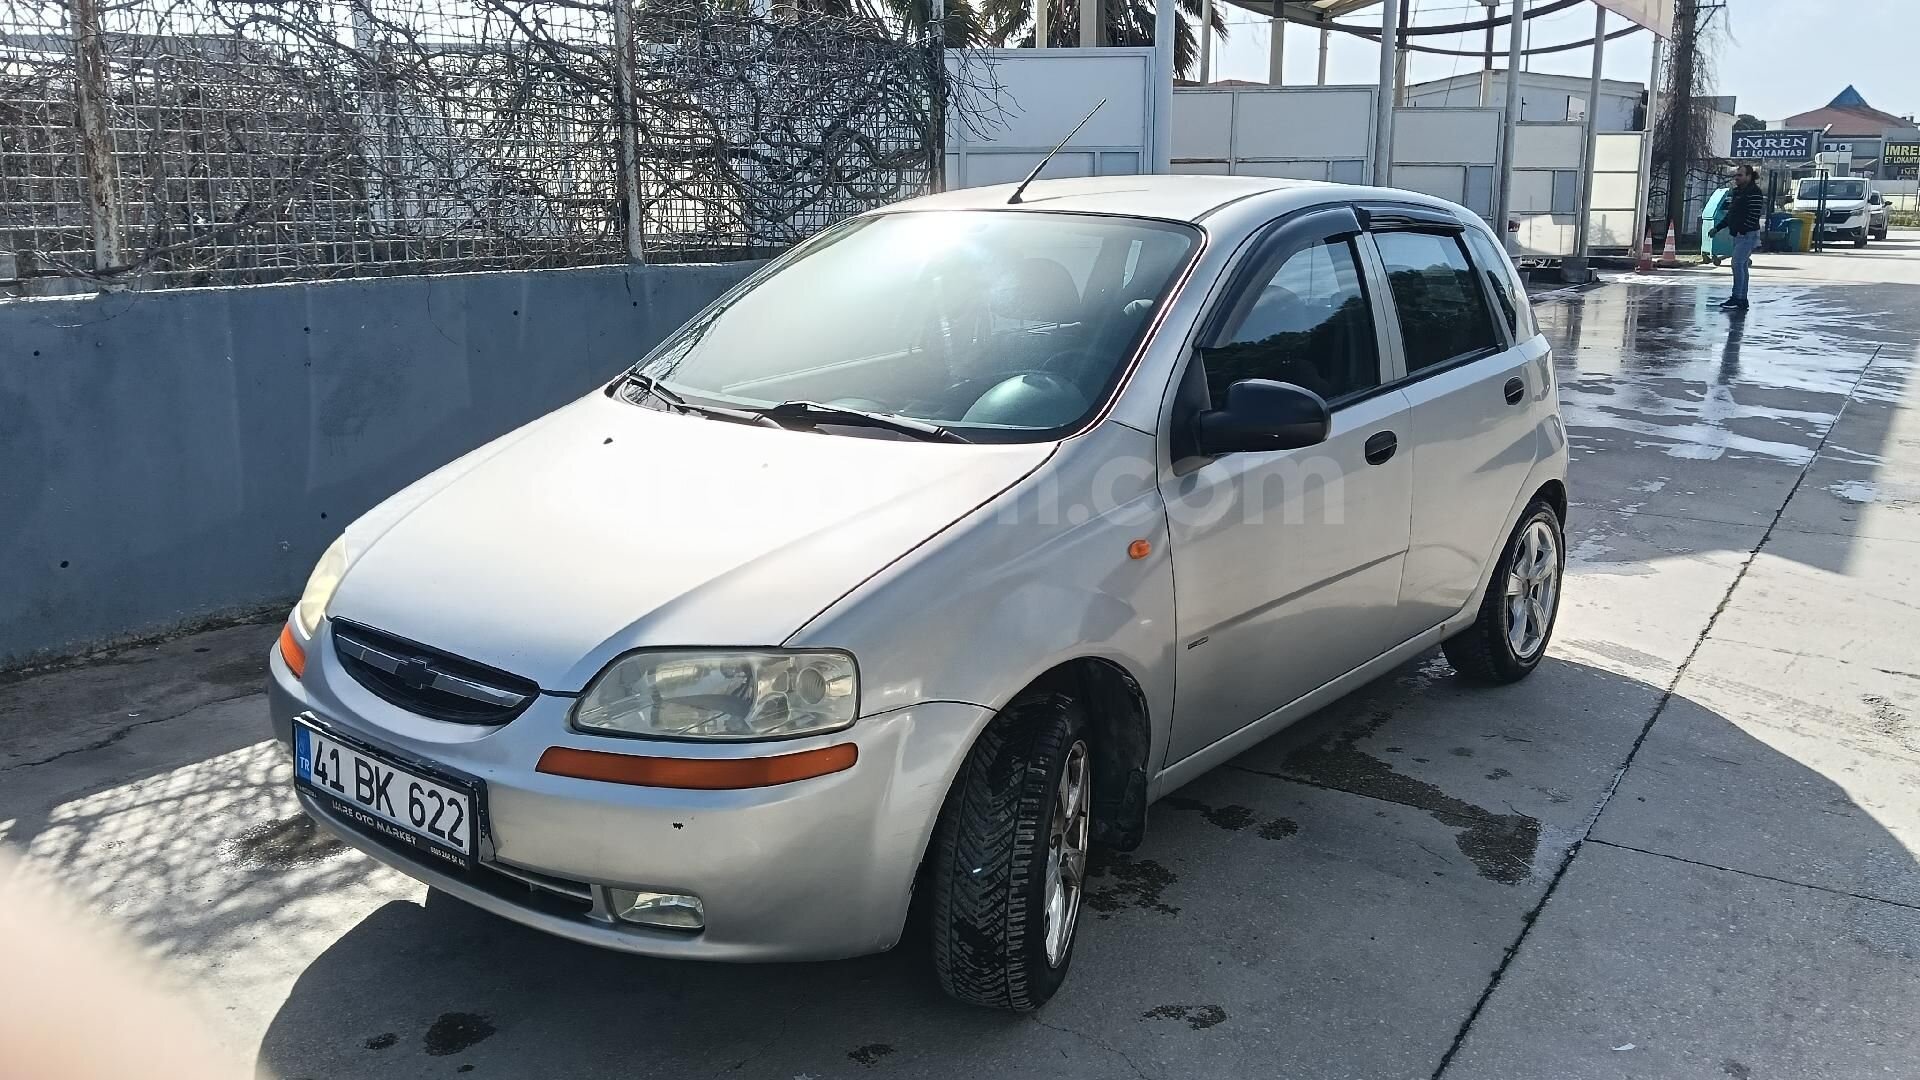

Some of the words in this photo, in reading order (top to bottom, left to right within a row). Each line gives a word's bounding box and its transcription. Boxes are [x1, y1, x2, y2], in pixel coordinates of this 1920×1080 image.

[1752, 149, 1806, 157] LOKANTASI
[1885, 142, 1920, 156] İMRE
[1884, 156, 1893, 164] ET
[299, 756, 310, 771] TR
[313, 740, 345, 794] 41
[354, 756, 397, 818] BK
[408, 781, 464, 848] 622
[355, 812, 375, 827] OTO
[376, 821, 417, 847] MARKET
